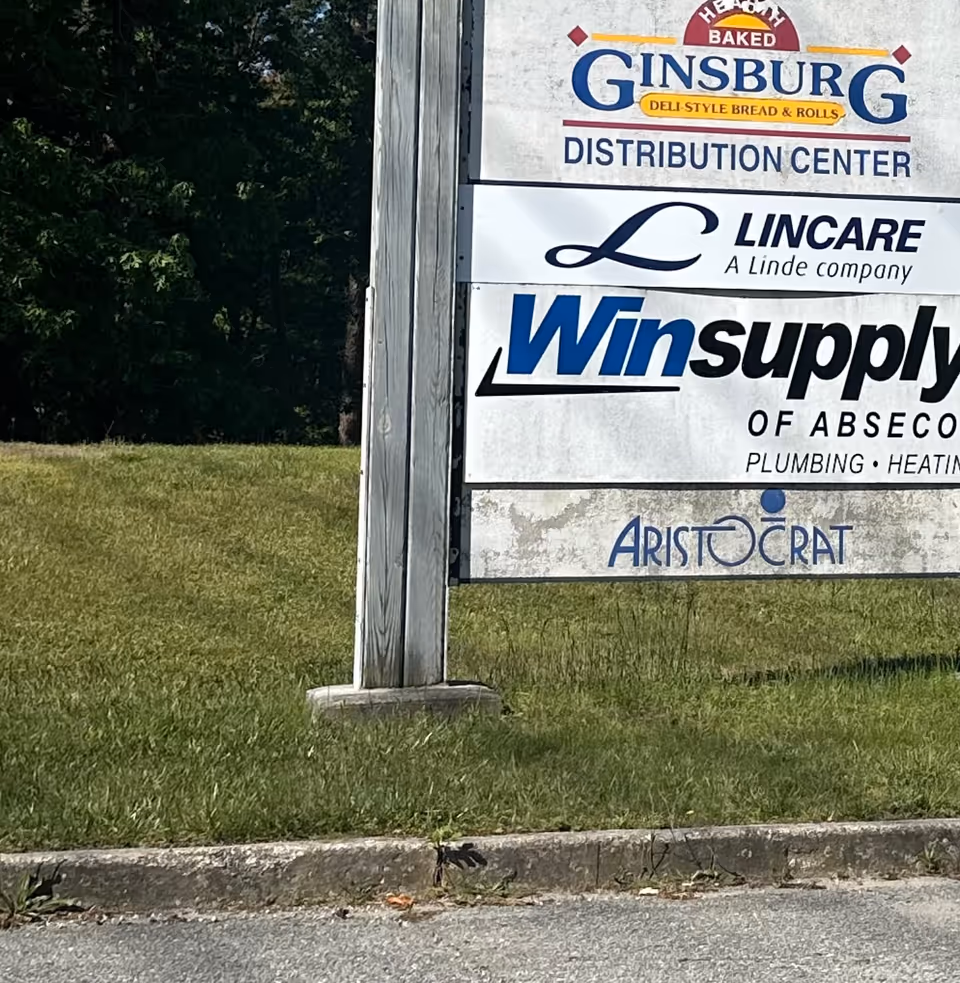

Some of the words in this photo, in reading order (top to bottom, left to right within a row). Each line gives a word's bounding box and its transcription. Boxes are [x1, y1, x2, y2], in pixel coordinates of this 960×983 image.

[708, 29, 776, 48] BAKED
[572, 48, 908, 125] GINSBURG
[731, 104, 778, 117] BREAD
[782, 107, 793, 118] &
[796, 107, 840, 120] ROLLS
[563, 136, 781, 173] DISTRIBUTION
[790, 146, 911, 177] CENTER
[734, 213, 925, 253] LINCARE
[725, 257, 739, 275] A
[748, 256, 808, 278] Linde
[816, 263, 913, 285] company
[748, 409, 793, 438] OF
[746, 452, 864, 475] PLUMBING
[607, 515, 853, 567] ARISTOCRAT
